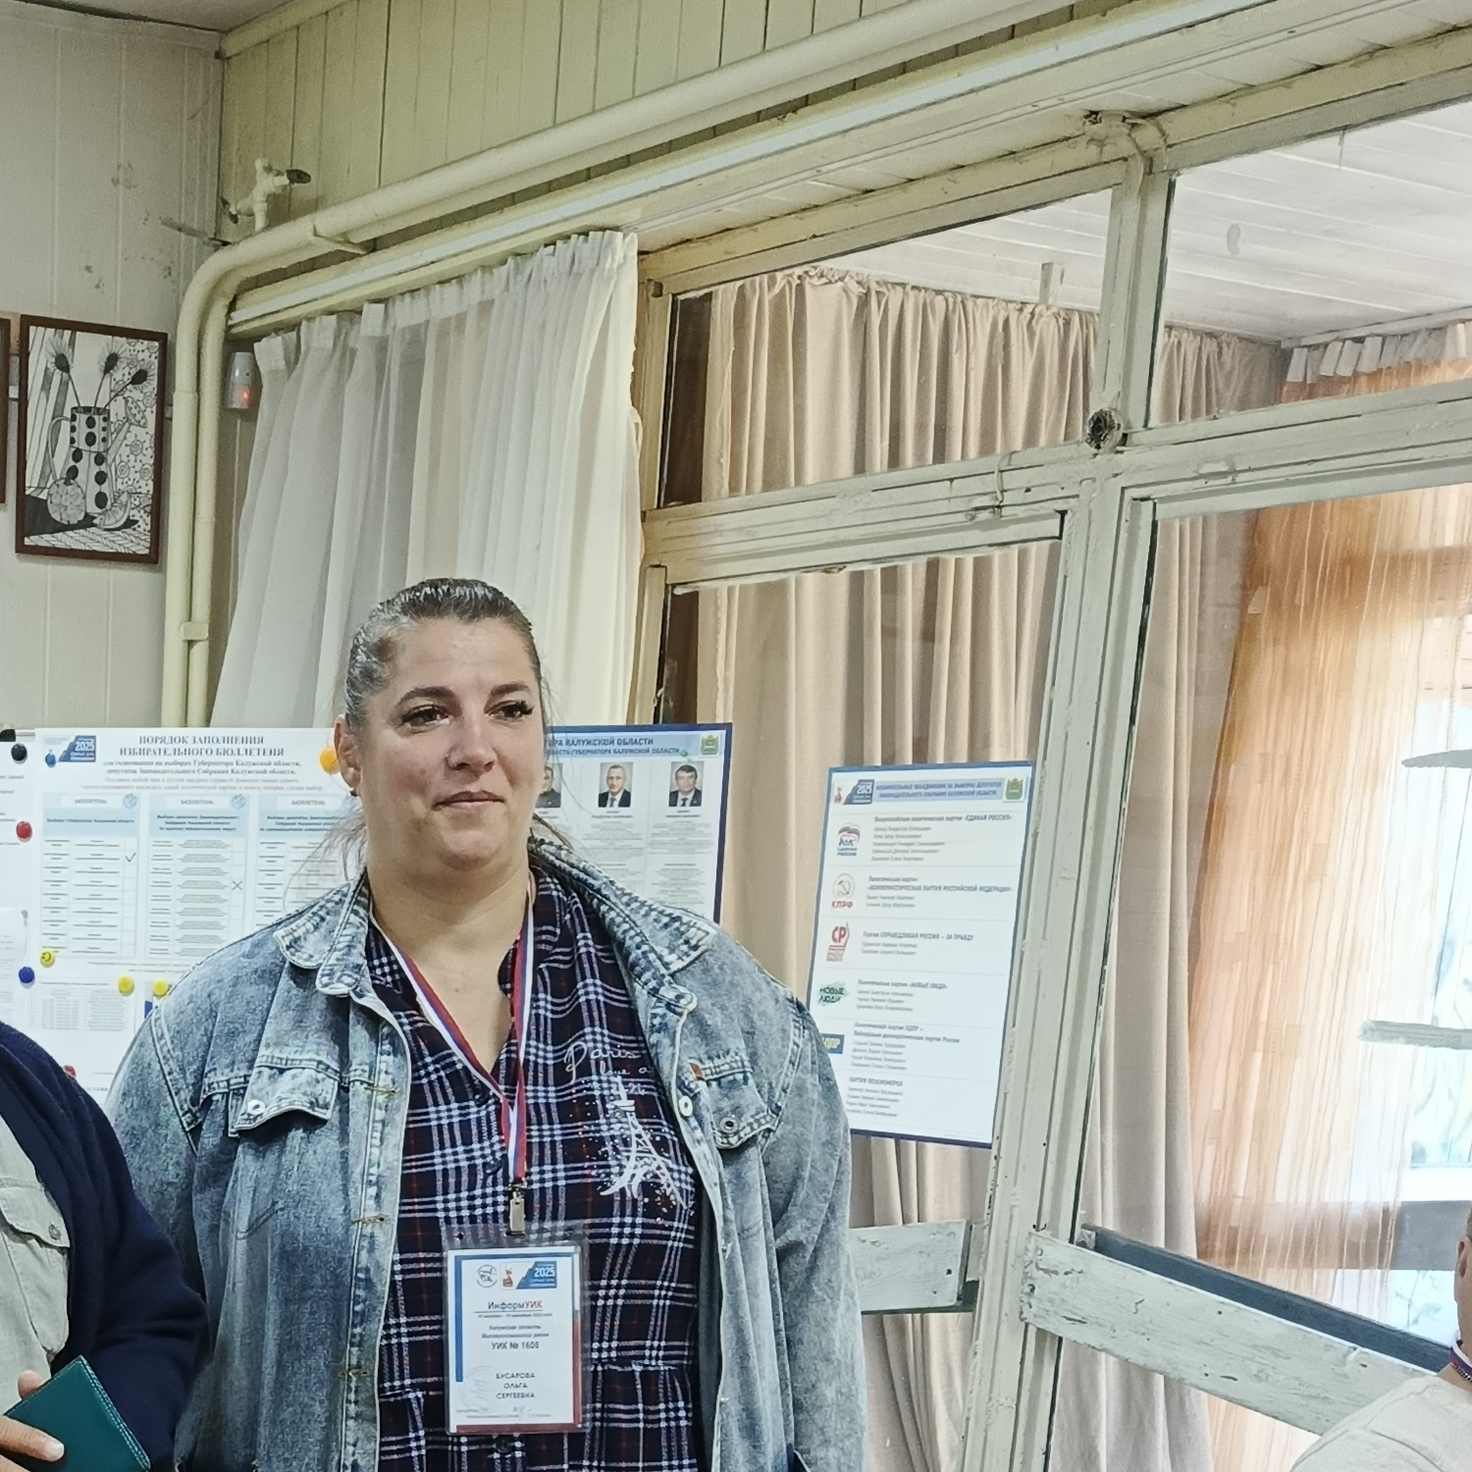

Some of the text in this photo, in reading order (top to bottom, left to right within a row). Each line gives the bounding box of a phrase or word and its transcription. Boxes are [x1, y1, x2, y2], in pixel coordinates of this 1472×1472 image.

[139, 735, 264, 745] ПОРЯДОК ЗАПОЛНЕНИЯ
[617, 738, 654, 746] ОБЛАСТИ
[74, 741, 95, 752] 2025
[119, 747, 285, 757] ИЗБИРАТЕЛЬНОГО БЮЛЛЕТЕНЯ
[831, 901, 854, 909] КПРФ
[831, 926, 847, 943] СР
[819, 986, 845, 995] НОВЫЕ
[818, 996, 841, 1004] ЛЮДИ
[564, 1041, 642, 1085] Paris
[534, 1266, 556, 1278] 2025
[487, 1301, 543, 1312] ИнформУИК
[491, 1342, 508, 1350] УИК
[495, 1372, 536, 1380] БУСАРОВА
[496, 1392, 536, 1400] СЕРГЕЕВНА
